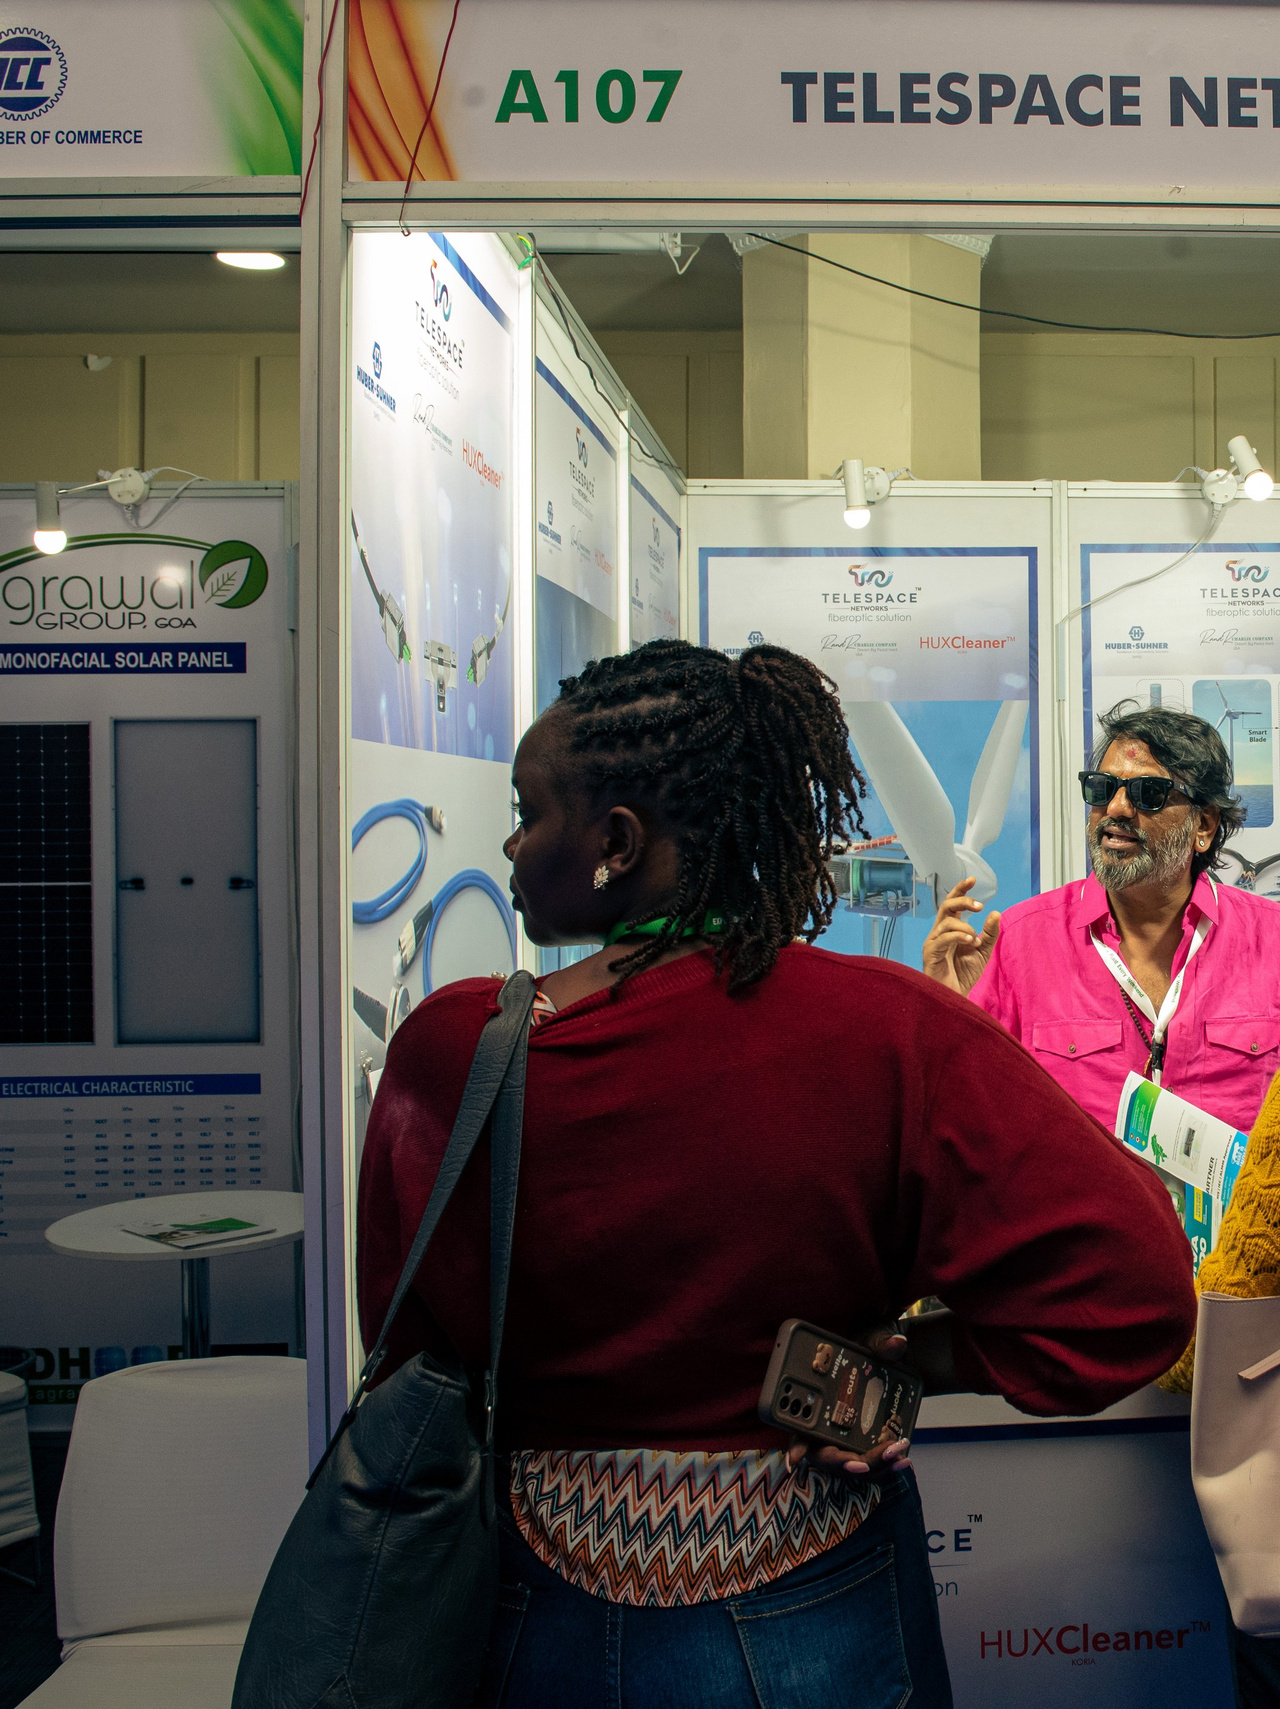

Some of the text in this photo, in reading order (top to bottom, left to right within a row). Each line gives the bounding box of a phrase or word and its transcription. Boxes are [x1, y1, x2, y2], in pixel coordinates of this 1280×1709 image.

[495, 69, 683, 123] A107
[781, 72, 1141, 126] TELESPACE
[29, 131, 142, 144] OF COMMERCE
[415, 300, 463, 369] TELESPACE
[822, 592, 918, 604] TELESPACE
[828, 612, 912, 624] fiberoptic solution
[1206, 607, 1250, 619] fiberoptic
[155, 617, 197, 628] GOA
[0, 651, 233, 668] MONOFACIAL SOLAR PANEL
[1248, 729, 1268, 737] Smart
[2, 1080, 194, 1095] ELECTRICAL CHARACTERISTIC
[1071, 1657, 1096, 1667] KORIA
